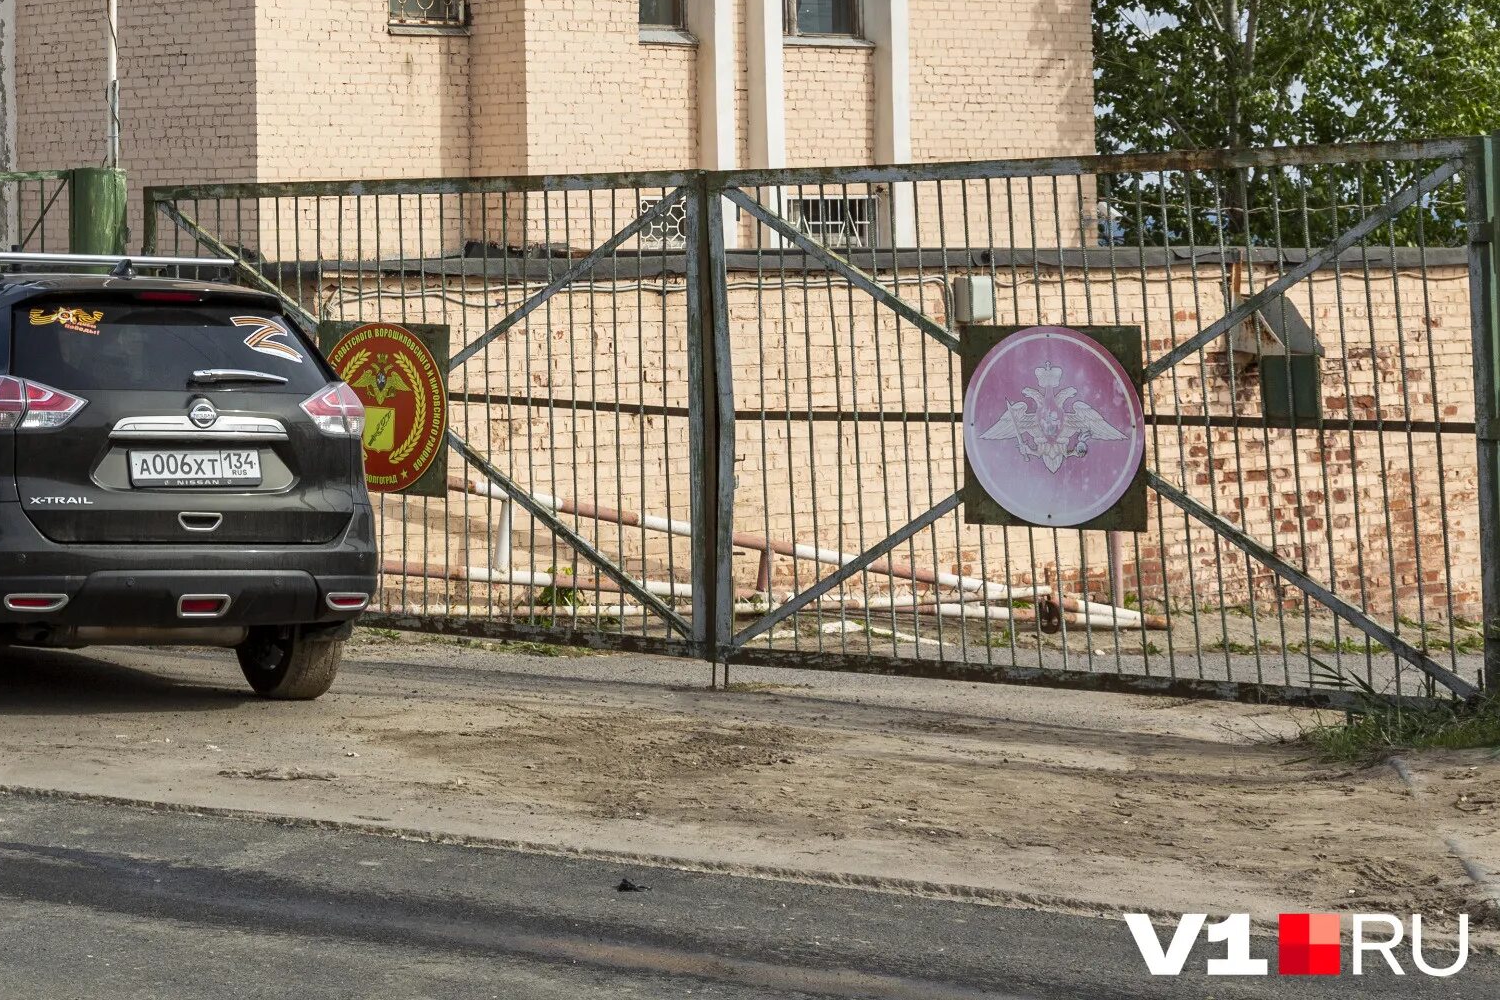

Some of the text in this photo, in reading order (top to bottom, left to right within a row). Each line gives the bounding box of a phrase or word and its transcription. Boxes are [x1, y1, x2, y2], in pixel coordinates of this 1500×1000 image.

[334, 329, 373, 363] СОВЕТСКОГО
[374, 328, 431, 371] ВОРОШИЛОВСКОГО
[429, 376, 441, 436] КИРОВСКОГО
[223, 453, 254, 470] 134
[412, 435, 436, 471] РАЙОНОВ
[29, 496, 94, 505] X-TRAIL
